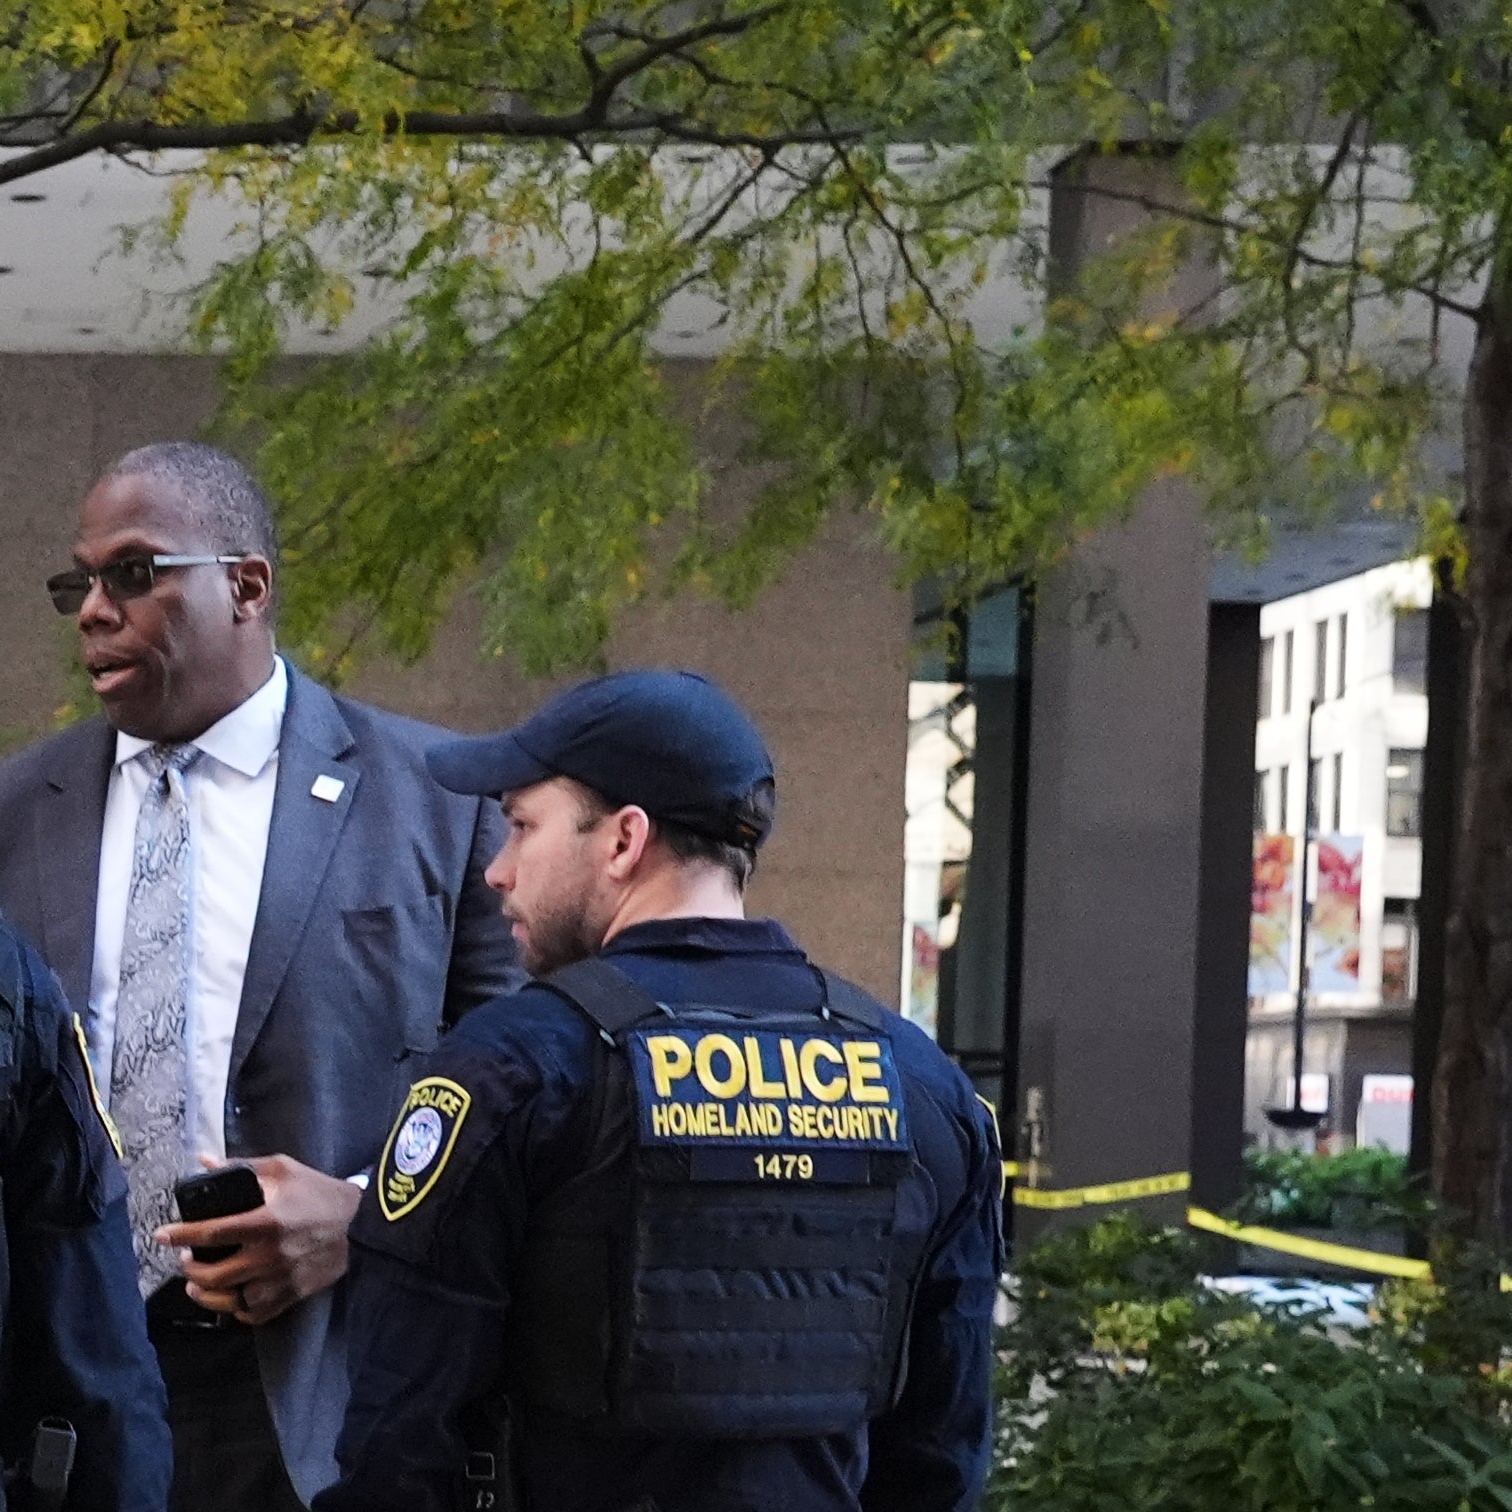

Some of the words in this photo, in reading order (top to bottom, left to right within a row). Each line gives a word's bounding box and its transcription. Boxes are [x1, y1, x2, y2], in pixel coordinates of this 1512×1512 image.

[646, 1033, 890, 1103] POLICE
[408, 1086, 463, 1118] POLICE
[652, 1102, 783, 1137] HOMELAND
[787, 1104, 898, 1142] SECURITY
[753, 1153, 814, 1180] 1479
